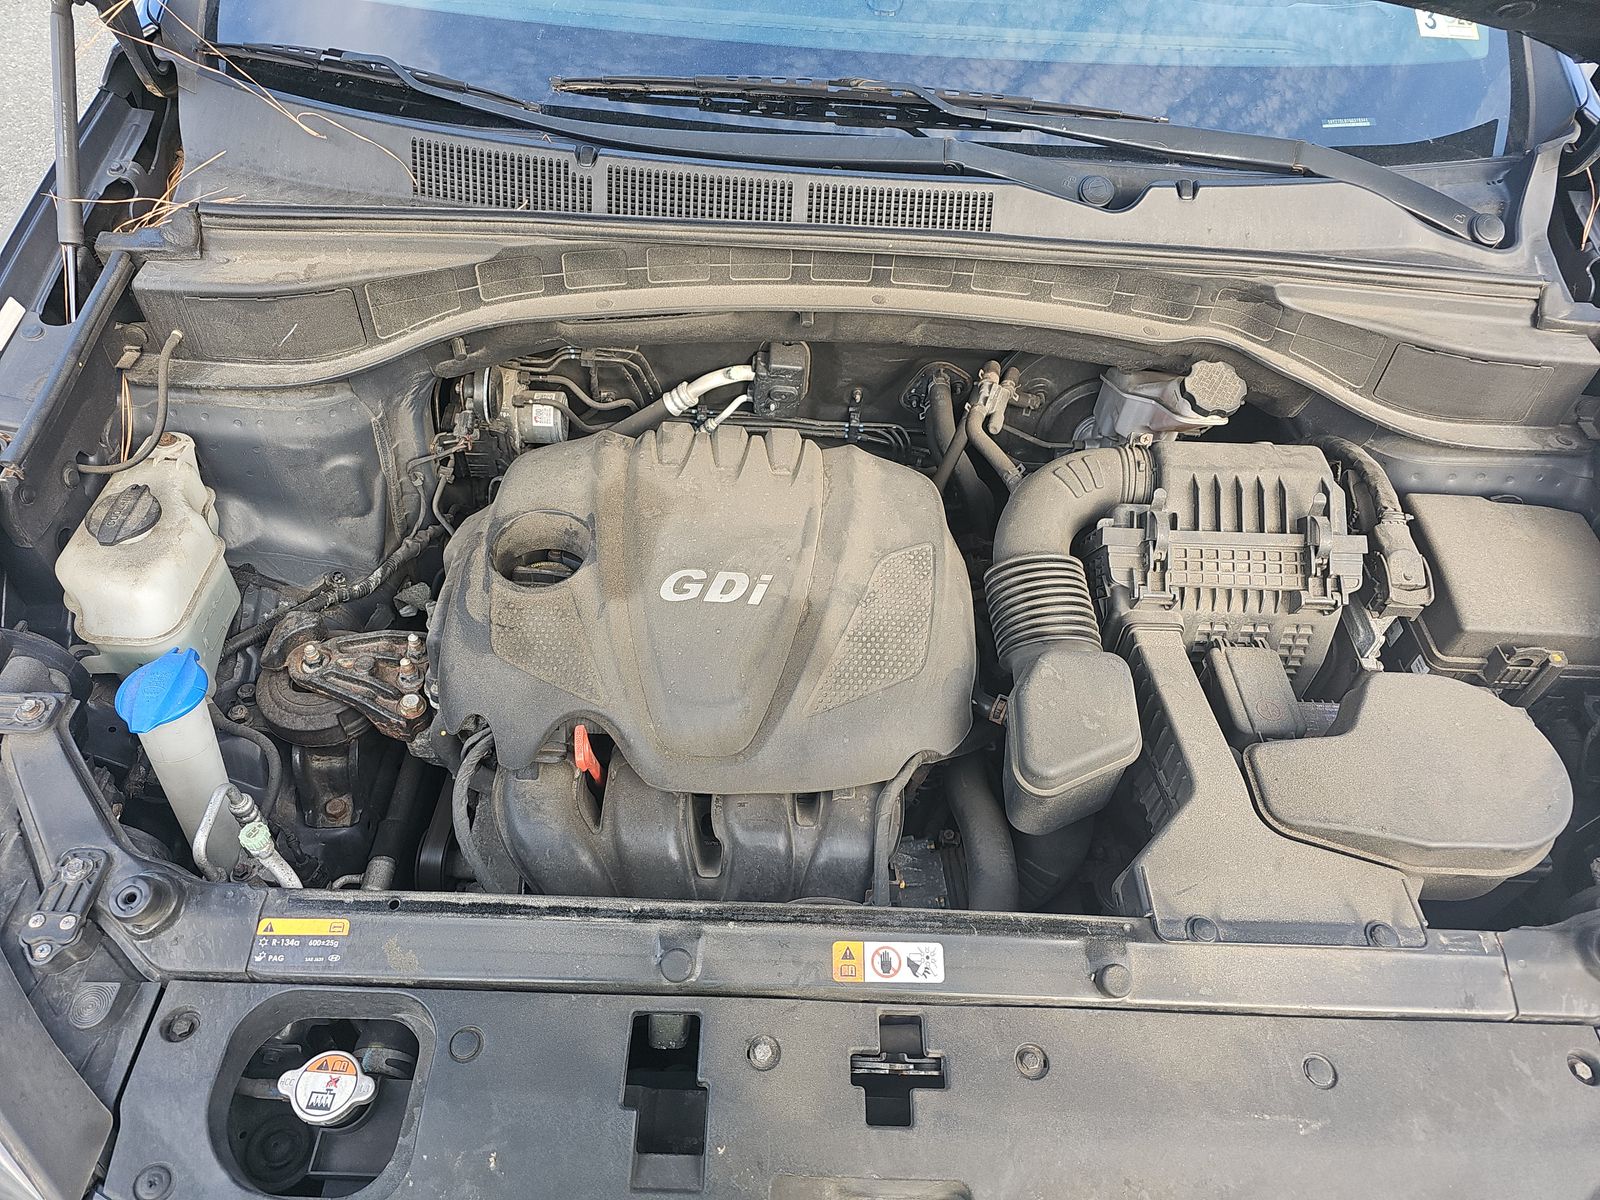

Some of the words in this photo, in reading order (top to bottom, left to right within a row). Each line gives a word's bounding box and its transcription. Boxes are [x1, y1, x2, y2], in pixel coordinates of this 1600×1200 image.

[1425, 12, 1436, 29] 3
[660, 569, 774, 605] GDi
[271, 938, 300, 947] R-134a
[308, 939, 339, 948] 600±25g
[267, 954, 285, 962] PAG
